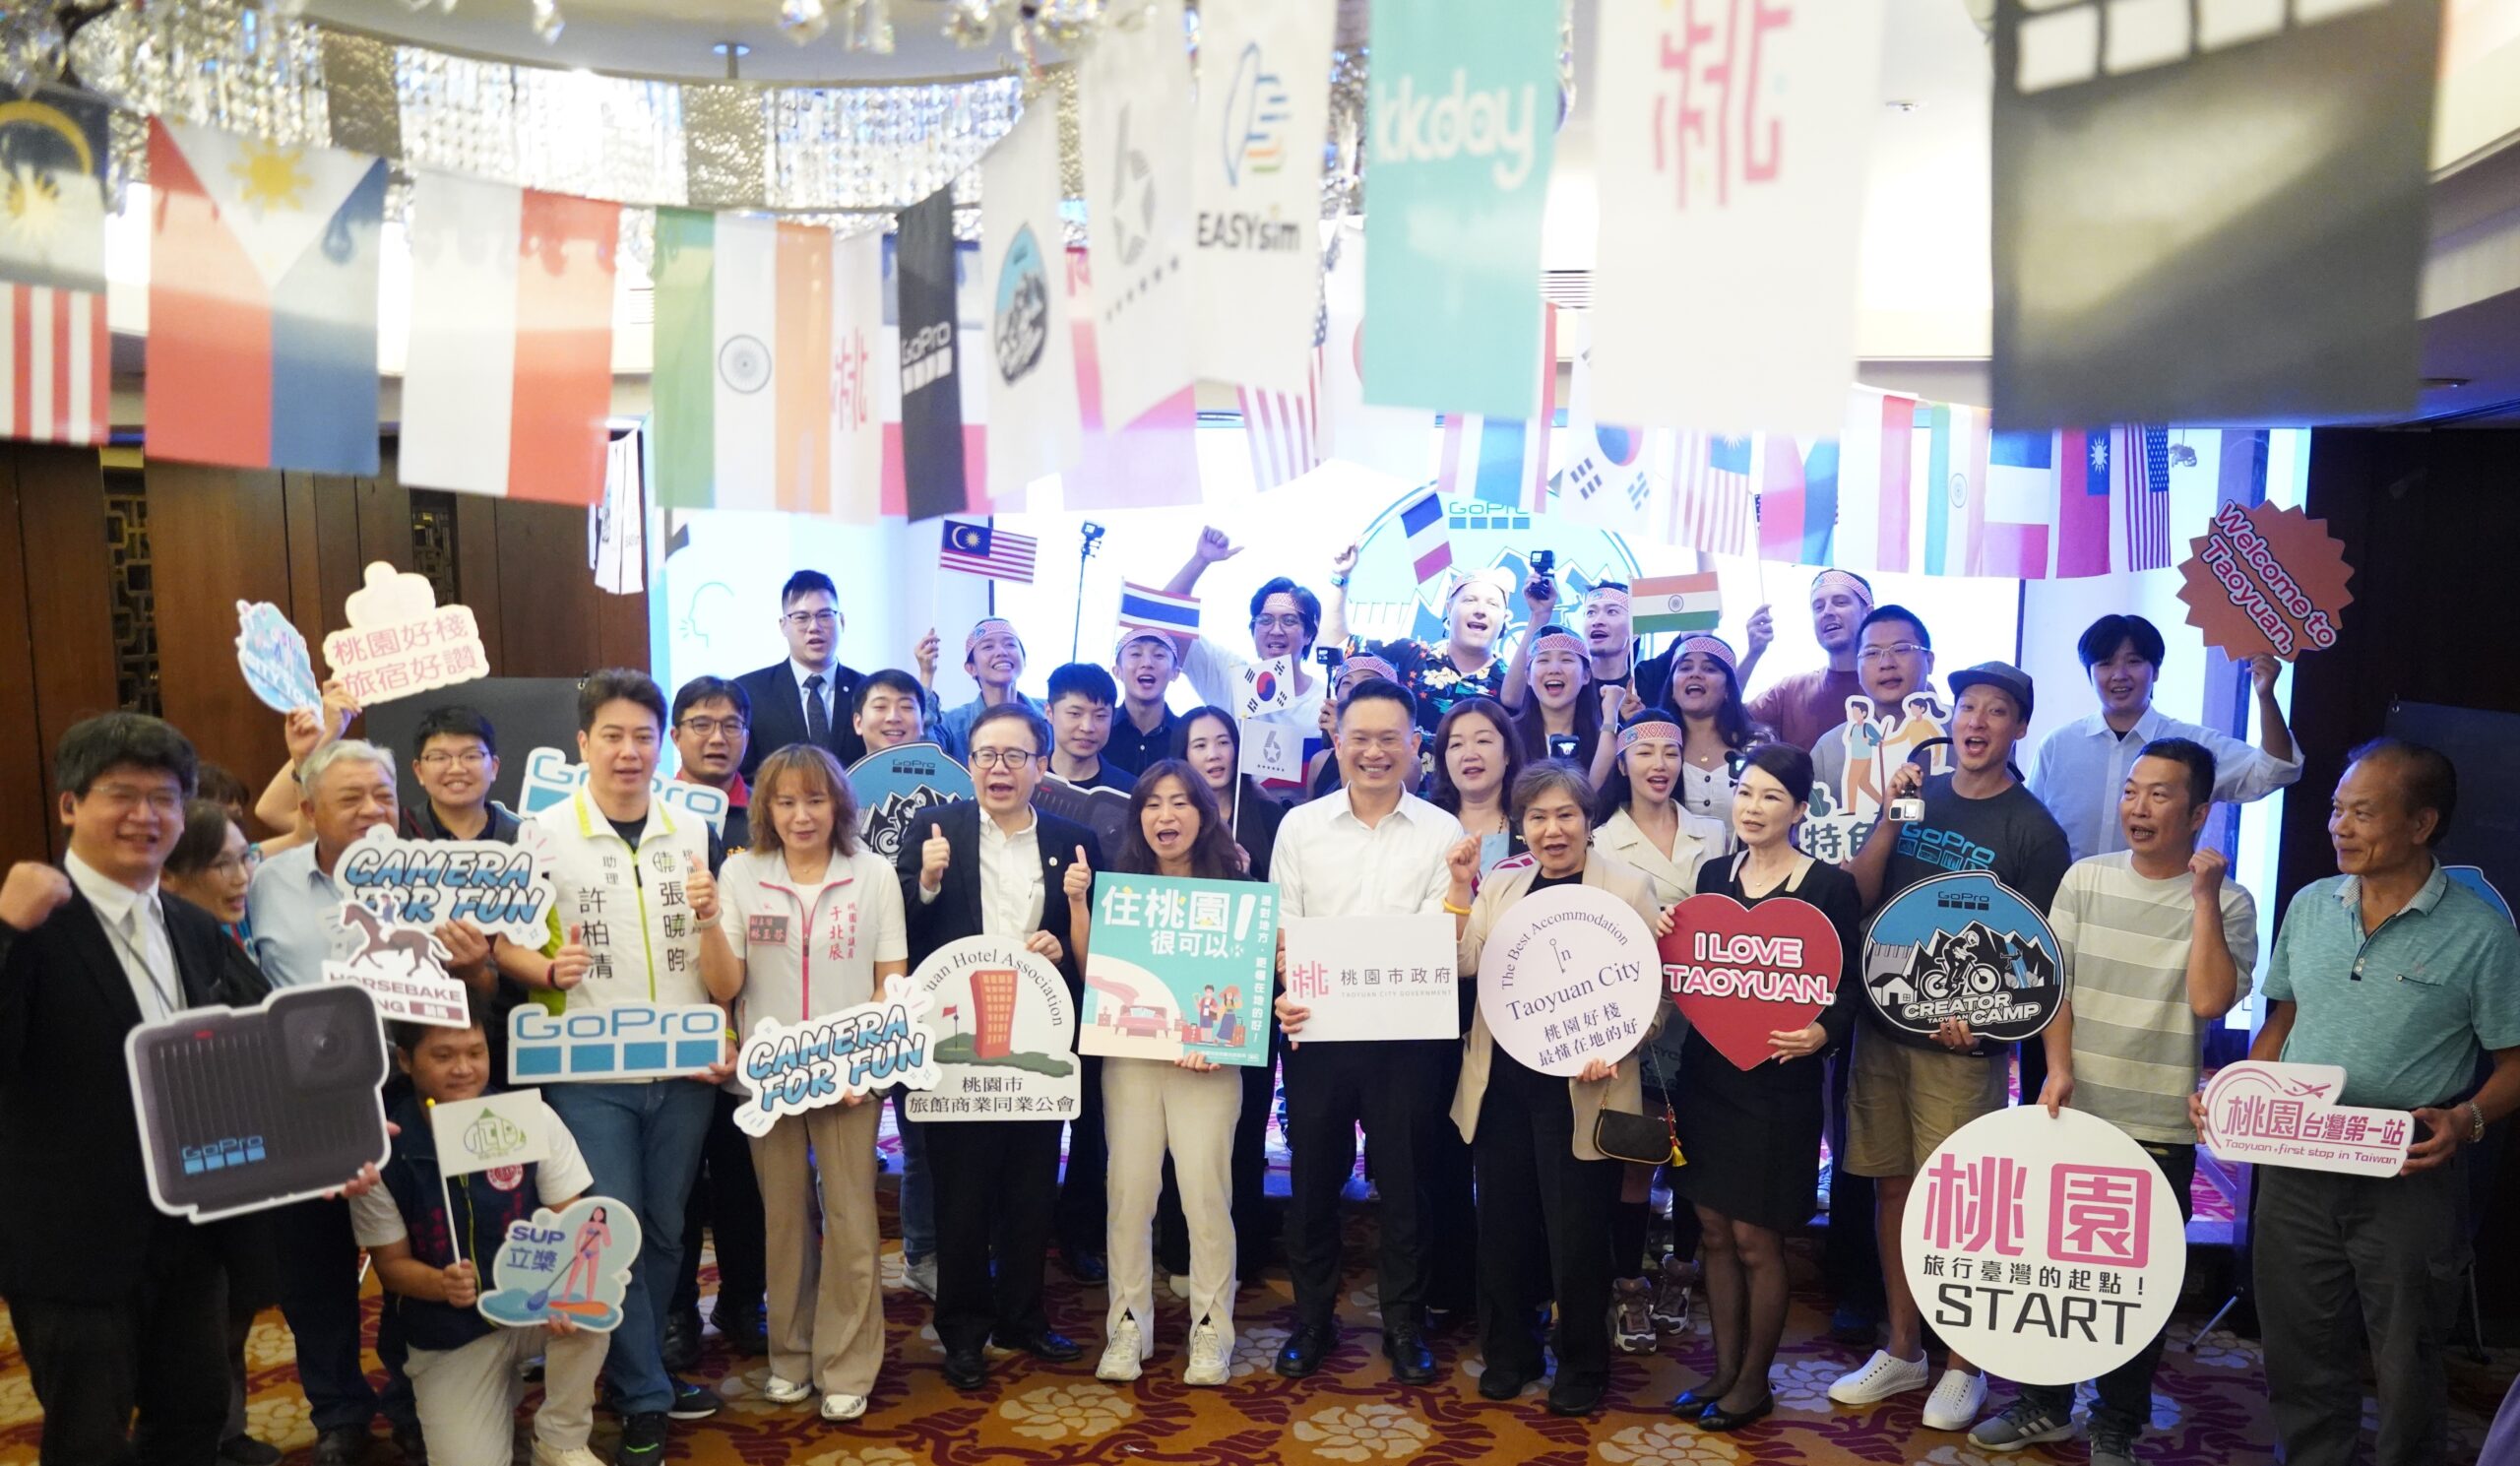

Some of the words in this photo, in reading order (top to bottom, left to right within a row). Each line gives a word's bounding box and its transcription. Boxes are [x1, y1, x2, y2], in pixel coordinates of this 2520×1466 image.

[1375, 67, 1537, 190] kkday
[1198, 207, 1300, 250] EASYsim
[2204, 537, 2292, 652] Taoyuan.
[2217, 501, 2311, 616] Welcome
[2306, 612, 2335, 646] to
[333, 613, 469, 666] 桃園好棧
[343, 645, 478, 698] 旅宿好讚
[892, 759, 936, 768] GoPro
[1901, 820, 1995, 862] GoPro
[345, 848, 533, 886] CAMERA
[602, 856, 619, 885] 助理
[450, 887, 548, 924] FUN
[1938, 891, 1989, 902] GoPro
[578, 887, 614, 980] 許柏清
[659, 881, 686, 972] 張曉昀
[1501, 964, 1515, 990] The
[1508, 933, 1531, 961] Best
[1531, 911, 1629, 946] Accommodation
[1695, 933, 1706, 959] I
[1711, 935, 1801, 966] LOVE
[953, 948, 997, 969] Hotel
[1001, 952, 1063, 1026] Association
[1341, 967, 1451, 986] 桃園市政府
[1505, 979, 1595, 1022] Taoyuan
[1599, 960, 1641, 987] City
[1665, 966, 1834, 1004] TAOYUAN.
[516, 1008, 720, 1040] GoPro
[1544, 1001, 1622, 1043] 桃園好棧
[1903, 992, 2012, 1019] CREATOR
[1927, 1014, 1969, 1024] TAOYAN
[1970, 1002, 2042, 1026] CAMP
[747, 1004, 909, 1081] CAMERA
[1539, 1017, 1638, 1067] 最懂在地的好
[761, 1061, 836, 1112] FOR
[850, 1033, 925, 1086] FUN
[962, 1076, 1023, 1093] 桃園市
[909, 1096, 1075, 1114] 旅館商業同業公會
[182, 1135, 264, 1160] GoPro
[2308, 1147, 2334, 1159] stop
[2339, 1150, 2350, 1160] in
[2355, 1152, 2397, 1165] Taiwan
[1923, 1153, 2152, 1268] 桃園
[512, 1226, 565, 1244] SUP
[1923, 1254, 2144, 1296] 旅行臺灣的起點!
[1935, 1283, 2142, 1346] START
